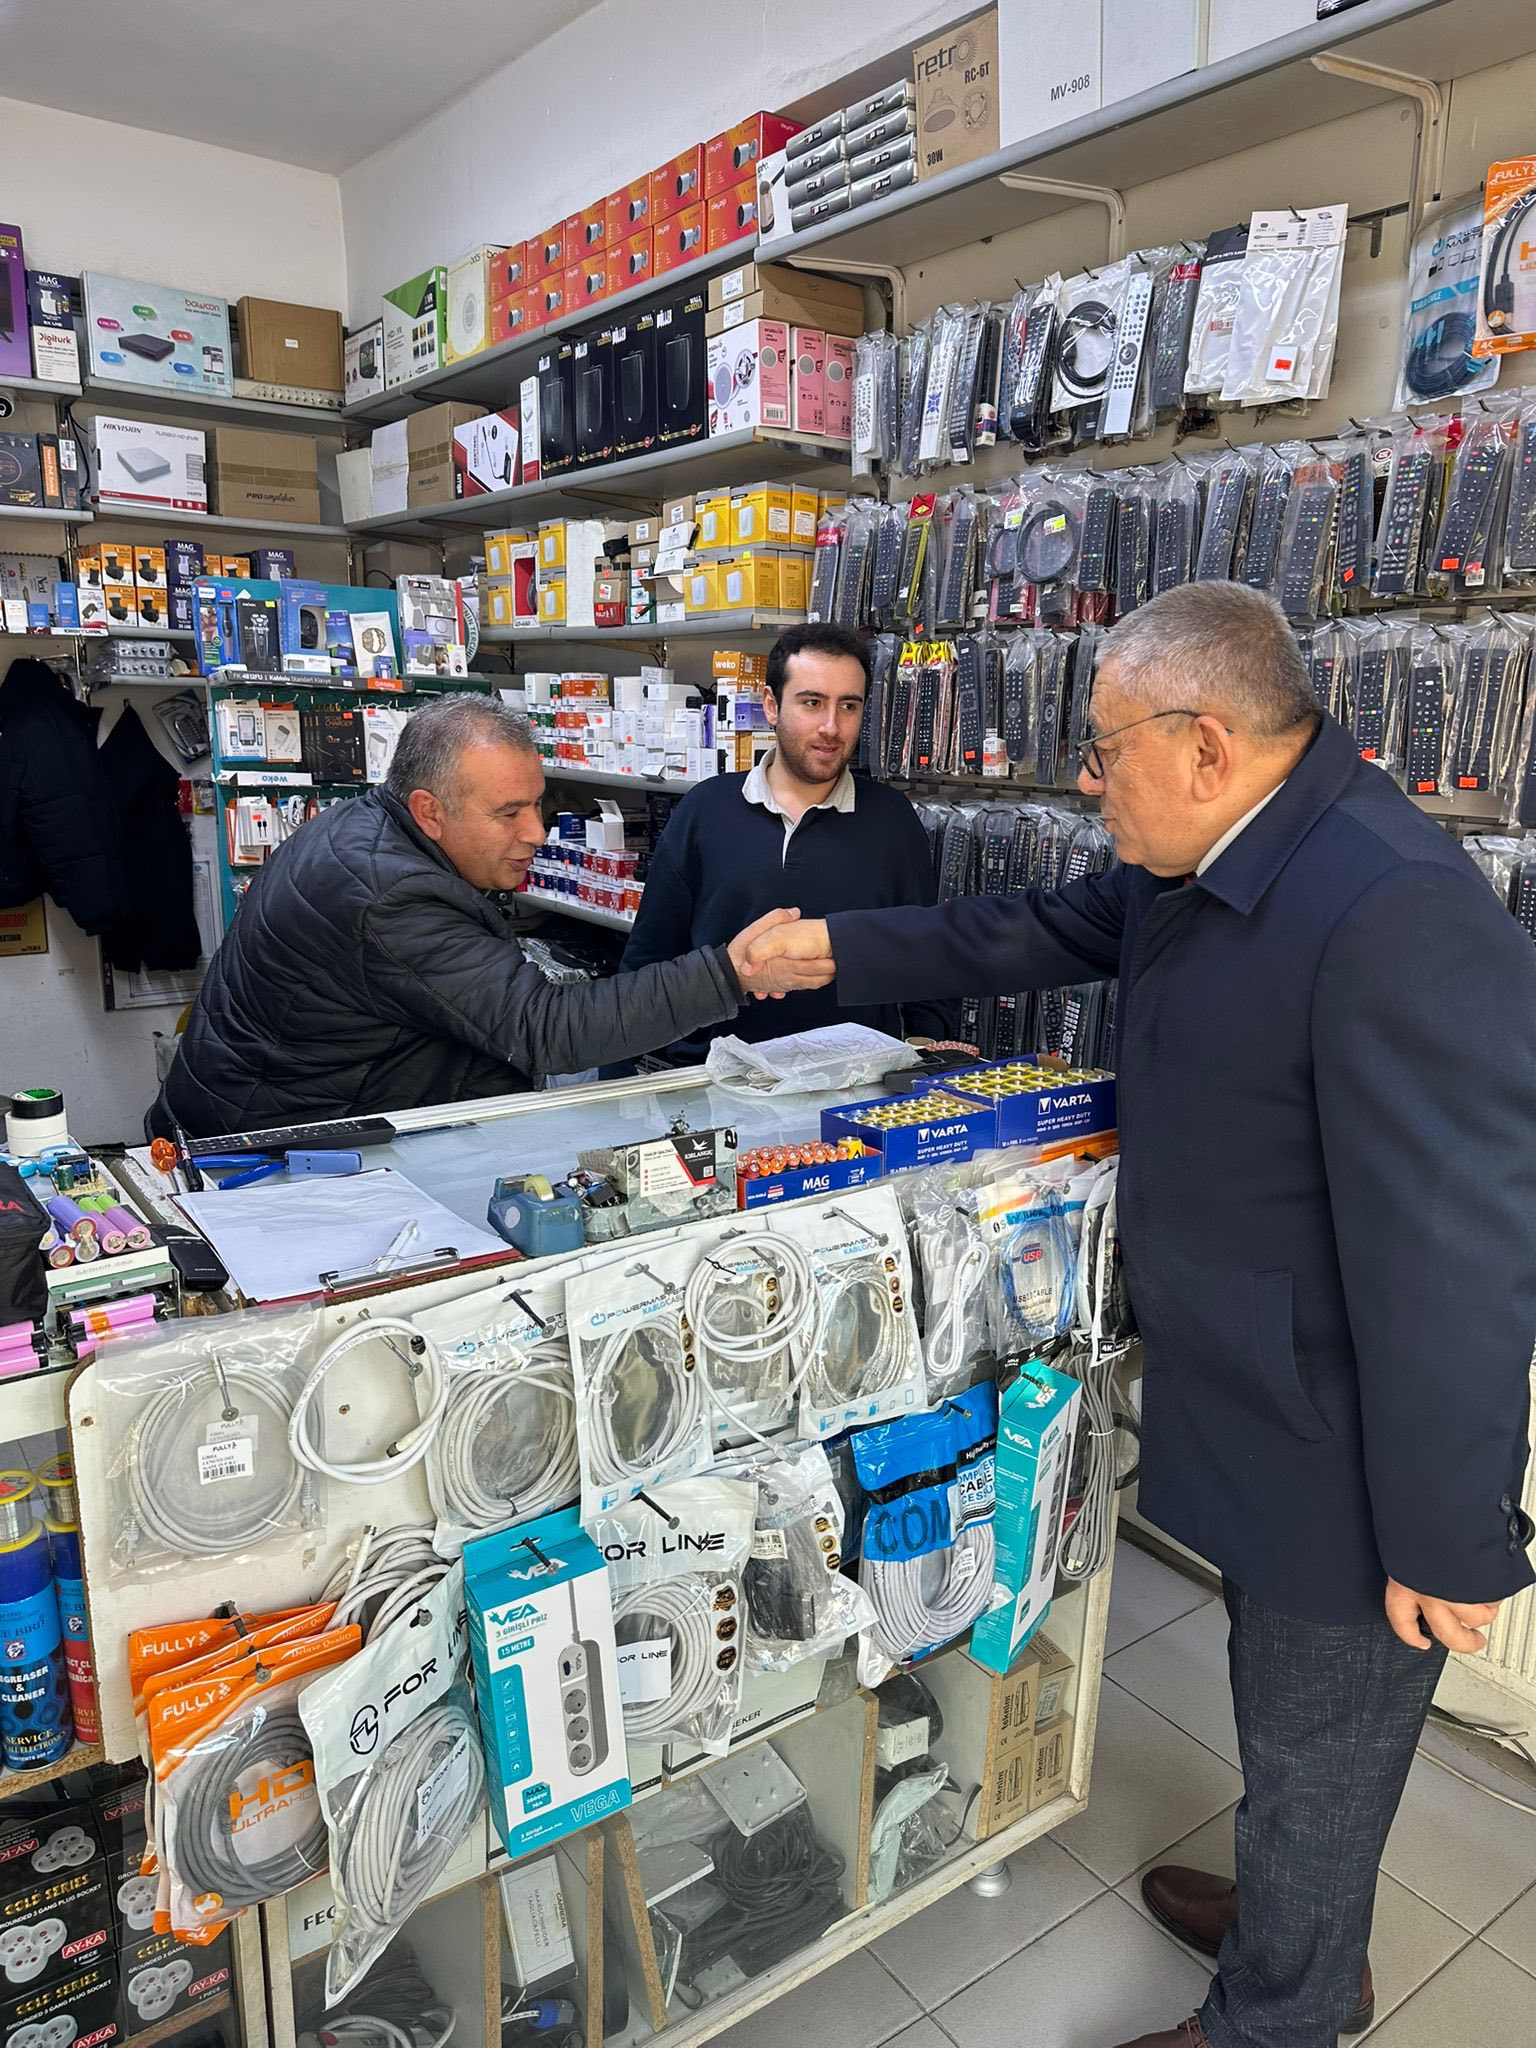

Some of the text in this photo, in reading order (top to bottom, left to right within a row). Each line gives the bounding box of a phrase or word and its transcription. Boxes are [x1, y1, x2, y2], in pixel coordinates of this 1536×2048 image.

[963, 61, 991, 85] RC-6T
[1050, 74, 1091, 102] MV-908
[926, 148, 944, 167] 30W
[1495, 166, 1529, 182] FULLY
[38, 275, 58, 286] MAG
[38, 331, 72, 346] Digiturk
[102, 422, 143, 435] HIKVISION
[246, 491, 264, 500] PRO
[177, 542, 194, 552] MAG
[267, 551, 284, 560] MAG
[174, 587, 192, 596] MAG
[715, 660, 736, 670] weko
[262, 775, 288, 783] weko
[1052, 1093, 1093, 1110] VARTA
[1037, 1111, 1092, 1127] SUPER HEAVY DUTY
[931, 1123, 969, 1139] VARTA
[917, 1146, 935, 1155] SUPER
[936, 1143, 953, 1151] HEAVY
[953, 1139, 968, 1148] DUTY
[803, 1175, 830, 1191] MAG
[1023, 1249, 1042, 1263] USB
[1102, 1343, 1113, 1353] 4K
[1003, 1427, 1033, 1450] VEA
[212, 1443, 232, 1453] FULLY
[600, 1530, 726, 1562] OR LINE
[495, 1602, 540, 1627] VEA
[530, 1613, 548, 1626] PRİZ
[15, 1618, 46, 1638] BIRD
[141, 1634, 197, 1658] FULLY
[290, 1632, 353, 1658] Deluxe Quality
[511, 1638, 532, 1655] METRE
[641, 1649, 668, 1660] LINE
[16, 1683, 25, 1693] &
[383, 1657, 439, 1714] FOR
[1, 1687, 46, 1703] CLEANER
[162, 1687, 218, 1721] FULLY
[1001, 1694, 1011, 1731] teknim
[6, 1728, 54, 1746] SERVICE
[1036, 1746, 1045, 1782] teknim
[228, 1759, 315, 1821] HD
[525, 1785, 547, 1796] MAX
[570, 1789, 621, 1823] VEGA
[45, 1872, 91, 1900] SERIES
[37, 1901, 58, 1915] GANG
[57, 1893, 77, 1908] PLUG
[76, 1883, 102, 1901] SOCKET
[64, 1932, 105, 1957] AY-KA
[78, 1949, 99, 1962] PIECE
[127, 1954, 163, 1974] GROUNDED
[167, 1944, 187, 1958] GANG
[55, 1970, 100, 1998] SERIES
[190, 1970, 228, 1995] AY-KA
[6, 2010, 44, 2032] GROUNDED
[49, 1999, 69, 2012] GANG
[68, 1991, 87, 2005] PLUG
[86, 1978, 112, 1998] SOCKET
[74, 2026, 115, 2048] AY-KA
